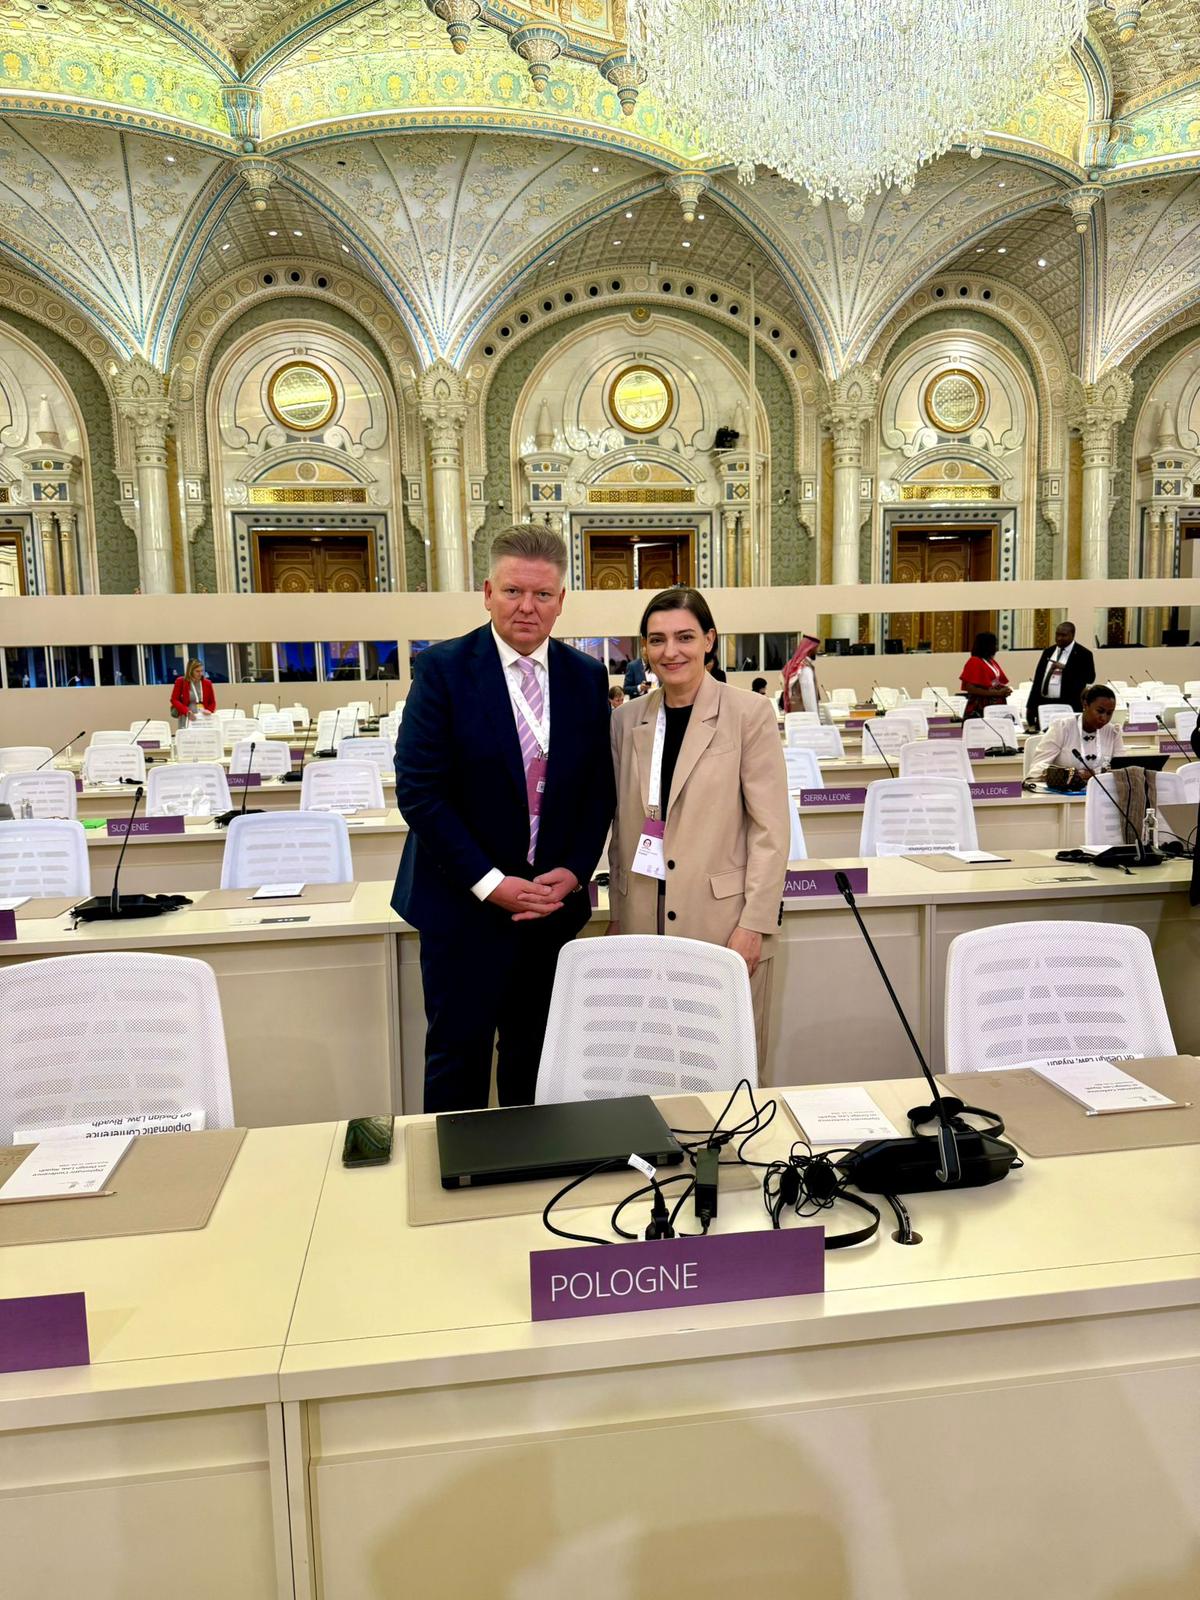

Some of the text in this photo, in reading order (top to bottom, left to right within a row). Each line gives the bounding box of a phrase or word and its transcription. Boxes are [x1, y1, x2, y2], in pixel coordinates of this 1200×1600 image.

[971, 787, 1009, 796] RRA LEONE
[804, 793, 851, 802] SIERRA LEONE
[111, 822, 150, 833] SLOENIE
[783, 879, 817, 892] ANDA
[142, 1122, 192, 1134] Diplomatic
[551, 1262, 698, 1302] POLOGNE
